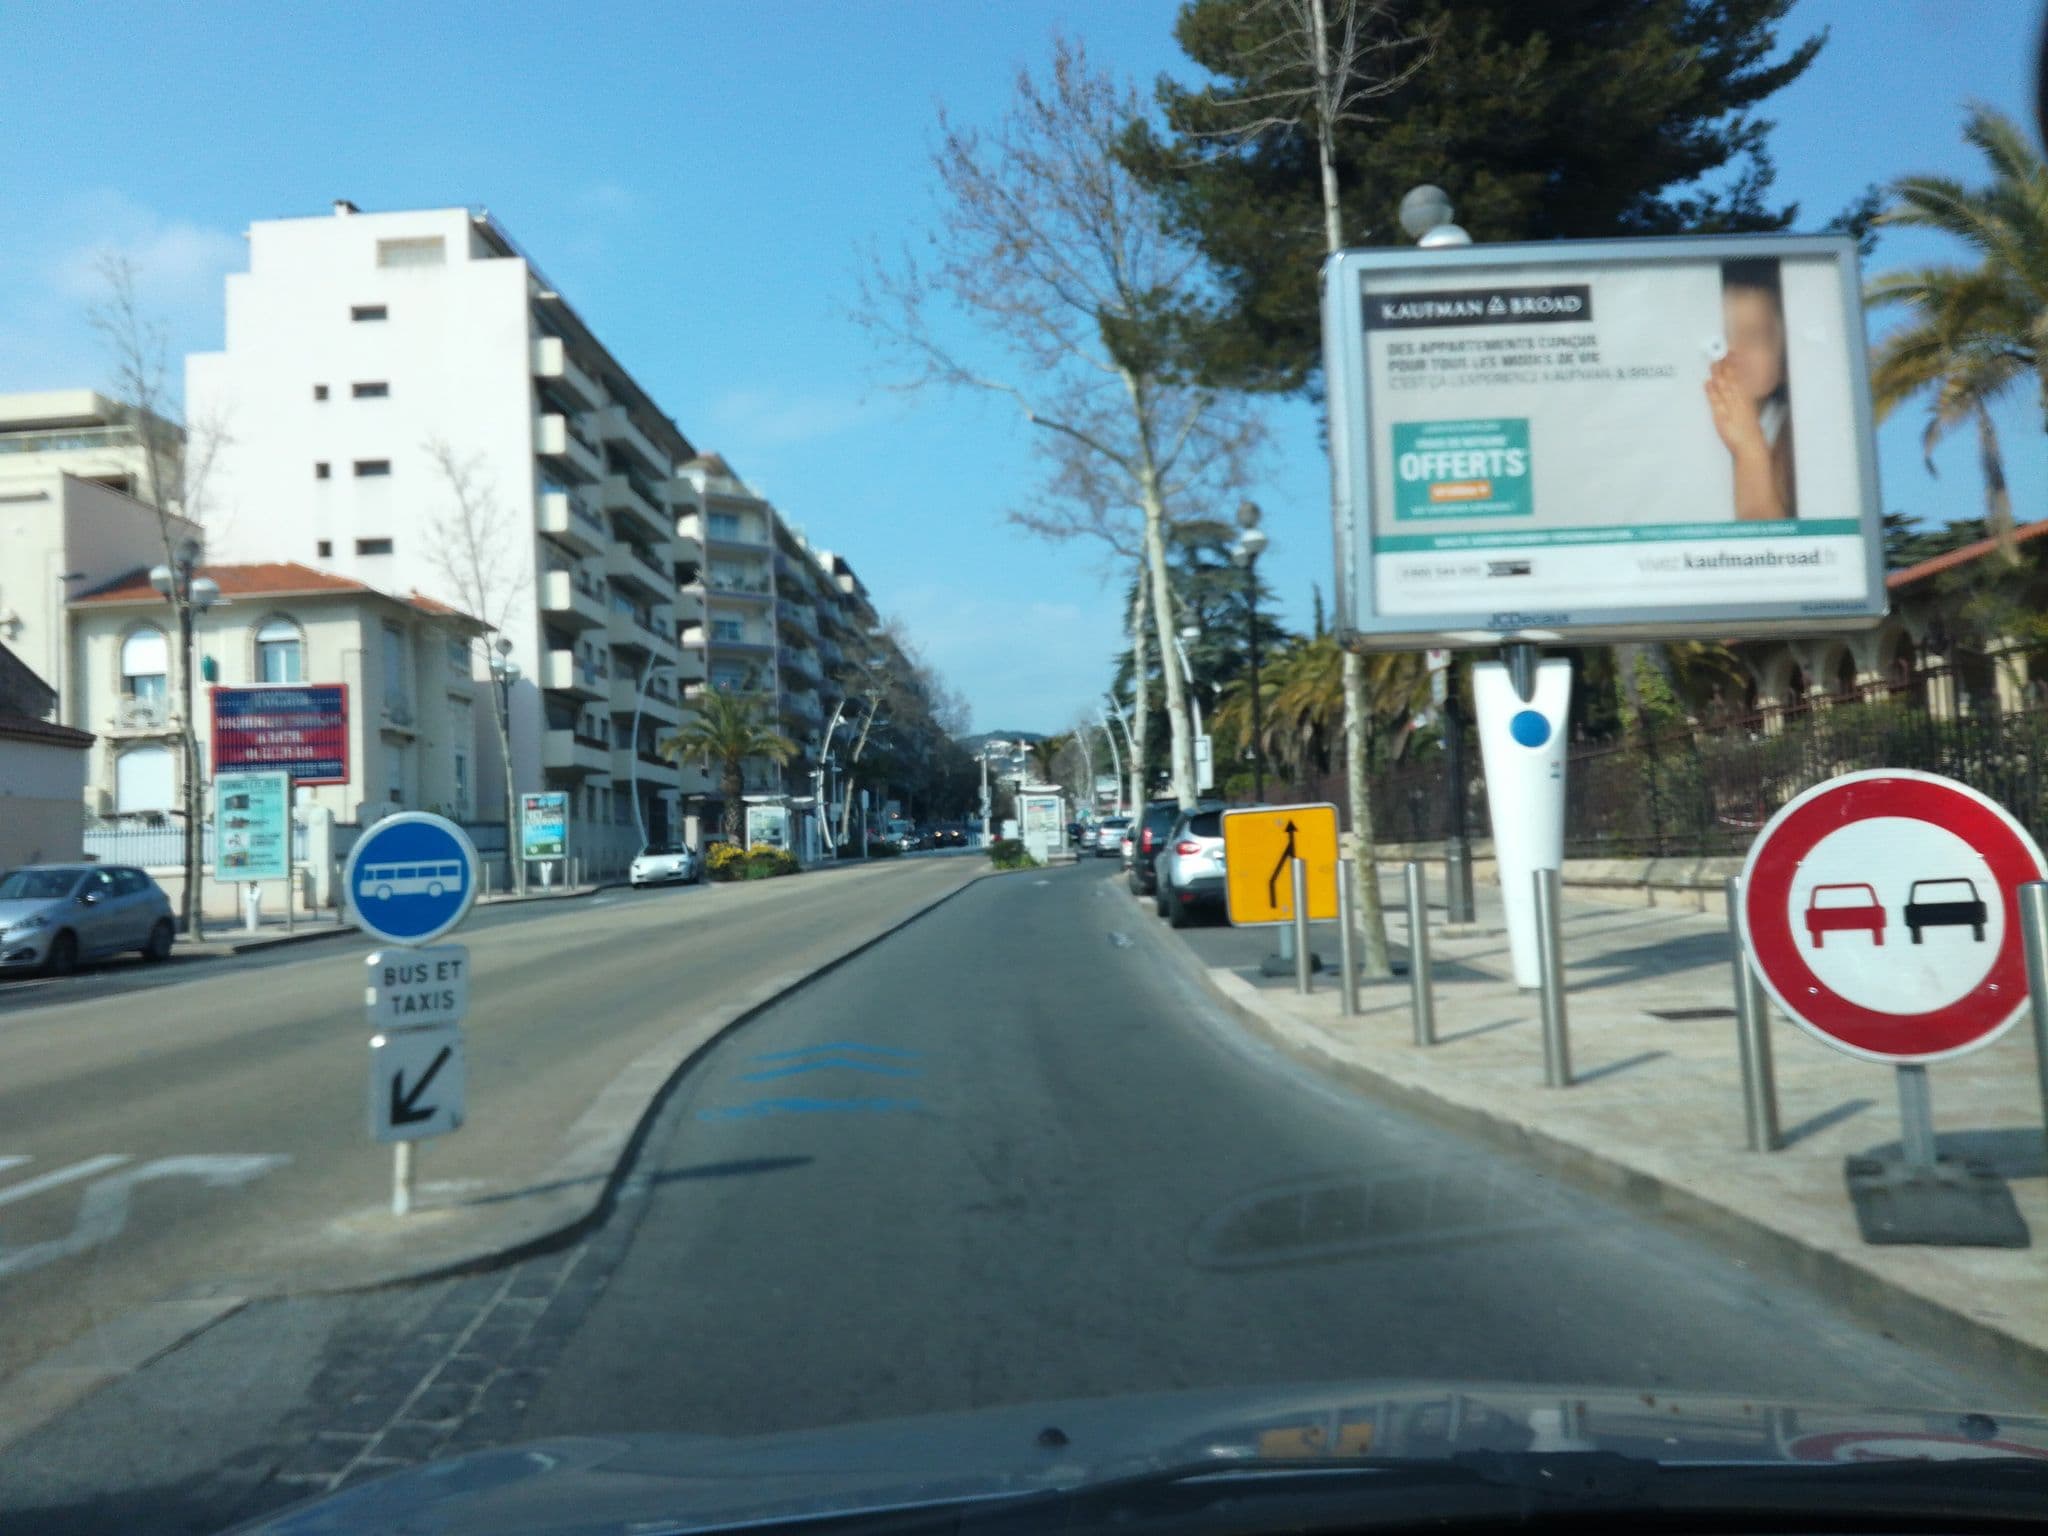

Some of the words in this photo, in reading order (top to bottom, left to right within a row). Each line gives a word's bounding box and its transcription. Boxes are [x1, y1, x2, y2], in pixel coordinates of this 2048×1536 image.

[1382, 299, 1483, 320] KAUFMAN
[1510, 294, 1583, 315] BROAD
[1418, 337, 1535, 354] APPARTEMENTS
[1388, 357, 1426, 372] POUR
[1400, 447, 1526, 481] OFFERTS
[1488, 611, 1570, 627] JCDecaux
[384, 964, 428, 987] BUS
[437, 960, 462, 981] ET
[392, 989, 455, 1015] TAXIS
